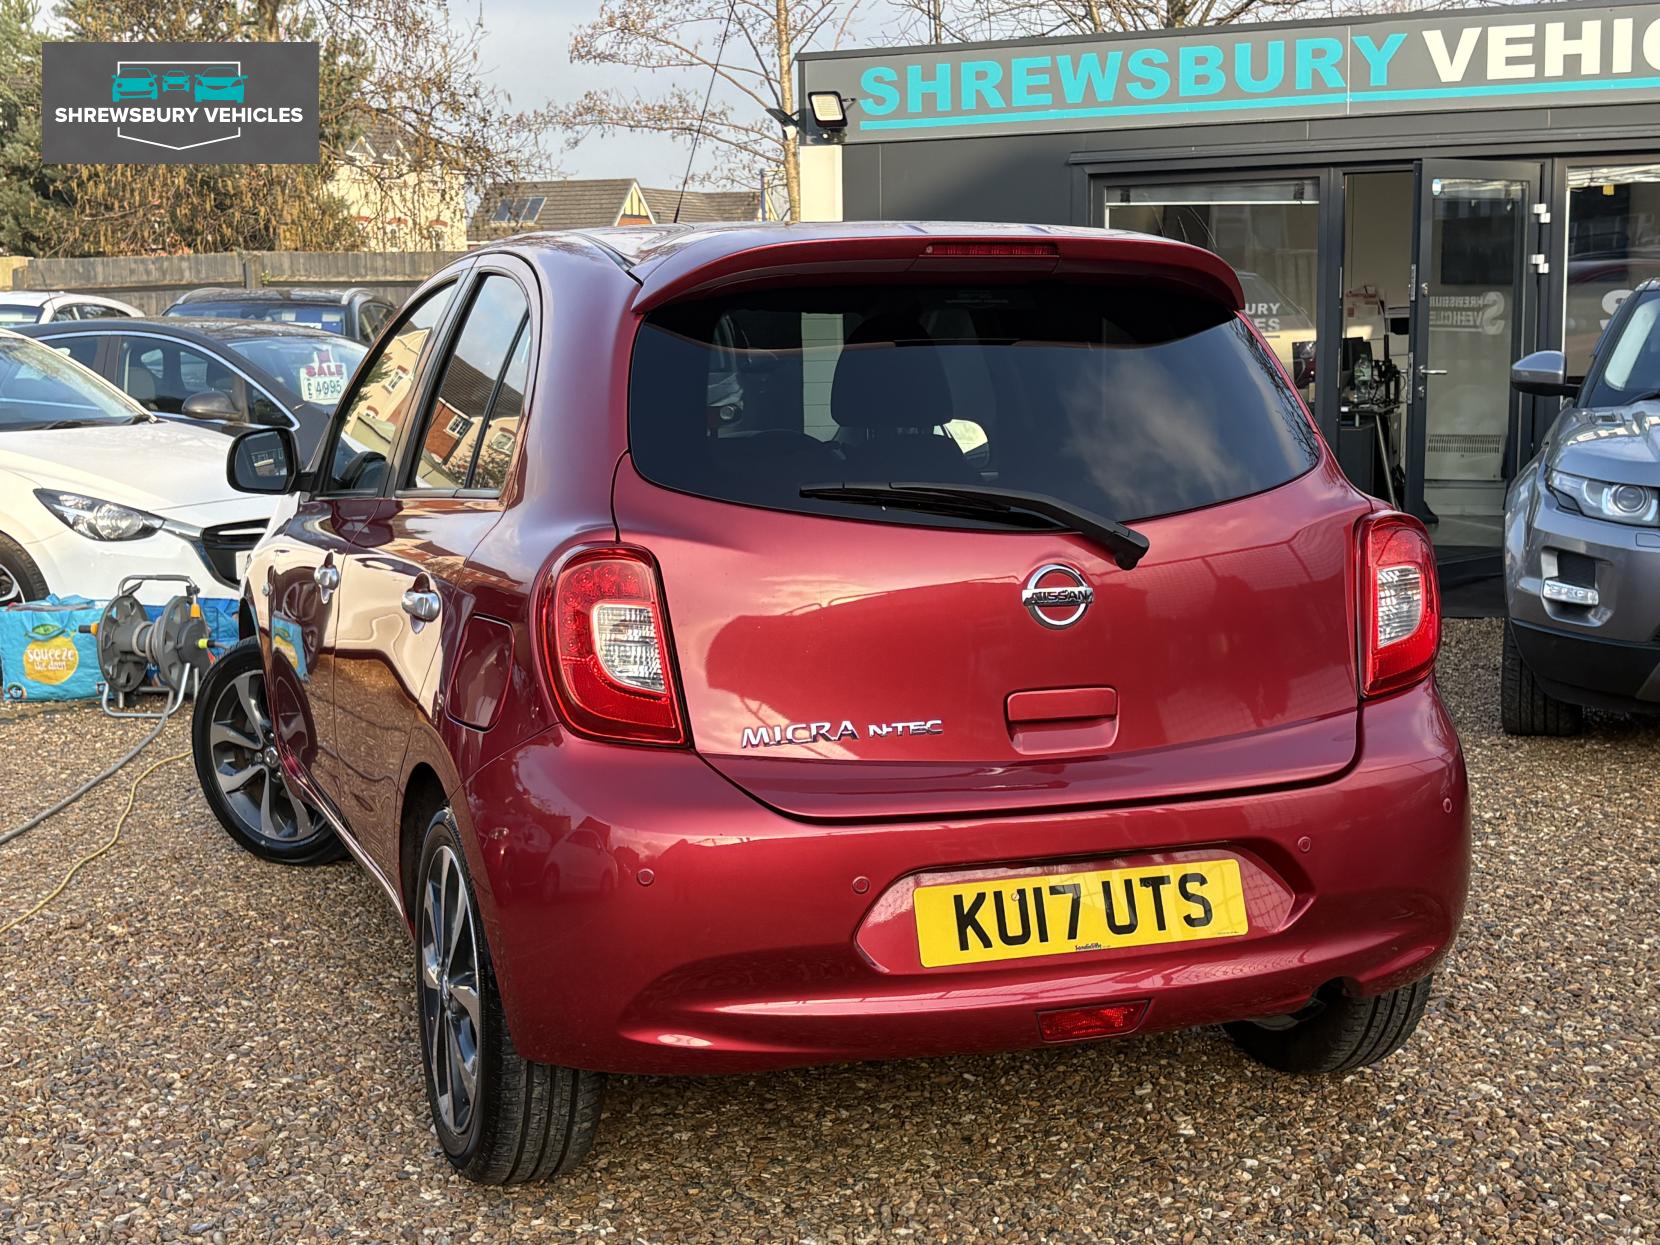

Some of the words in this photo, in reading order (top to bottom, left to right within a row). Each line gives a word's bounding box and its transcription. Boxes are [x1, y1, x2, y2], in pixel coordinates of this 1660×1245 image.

[859, 33, 1408, 116] SHREWSBURY
[1245, 302, 1280, 316] URY
[1031, 590, 1088, 602] NISSAN
[741, 720, 859, 748] MICRA
[868, 719, 943, 737] N-TEC
[1101, 872, 1213, 936] UTS
